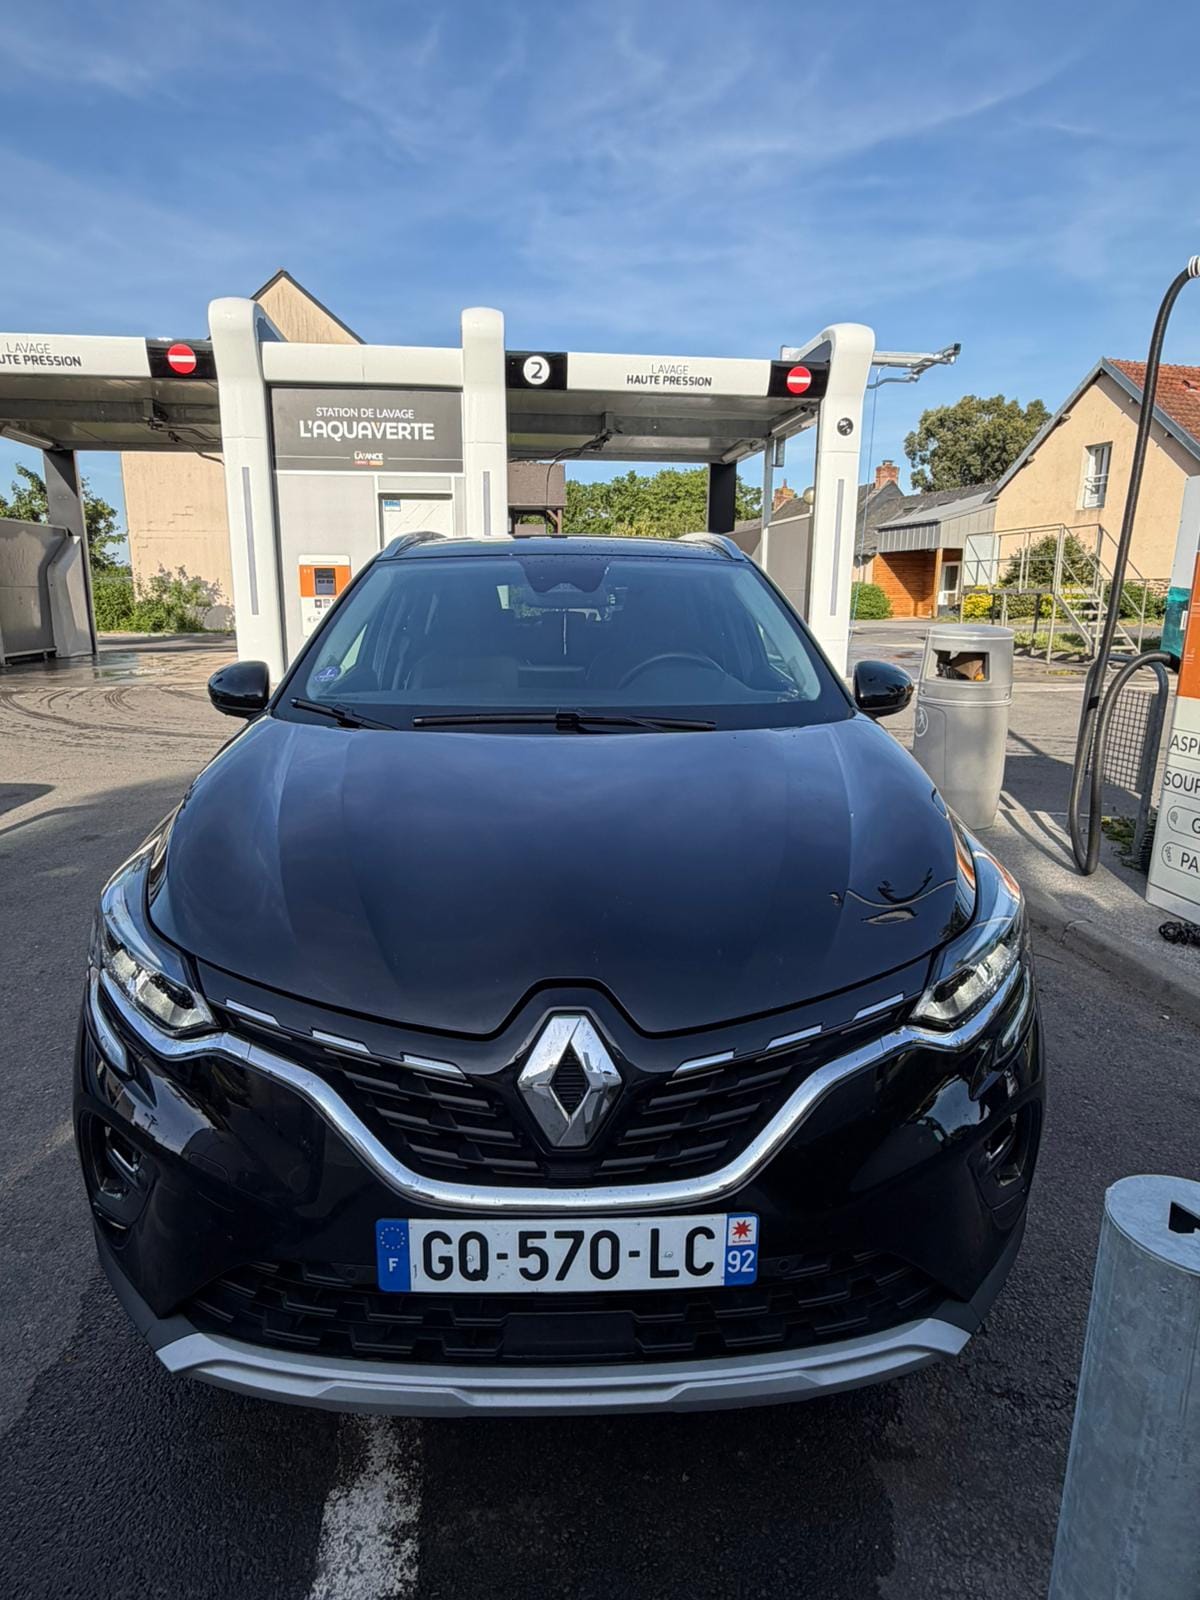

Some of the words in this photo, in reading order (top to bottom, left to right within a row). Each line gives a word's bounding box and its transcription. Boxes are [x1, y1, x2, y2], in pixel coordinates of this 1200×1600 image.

[6, 342, 51, 354] LAVAGE
[23, 355, 82, 367] PRESSION
[530, 361, 543, 379] 2
[651, 364, 689, 375] LAVAGE
[626, 375, 661, 385] HAUTE
[663, 376, 712, 387] PRESSION
[316, 407, 358, 418] STATION
[361, 408, 375, 418] DE
[377, 409, 415, 419] LAVAGE
[300, 420, 435, 441] L'AQUAVERTE
[422, 1226, 716, 1282] GQ-570-LC
[388, 1257, 399, 1273] F
[727, 1249, 755, 1274] 92
